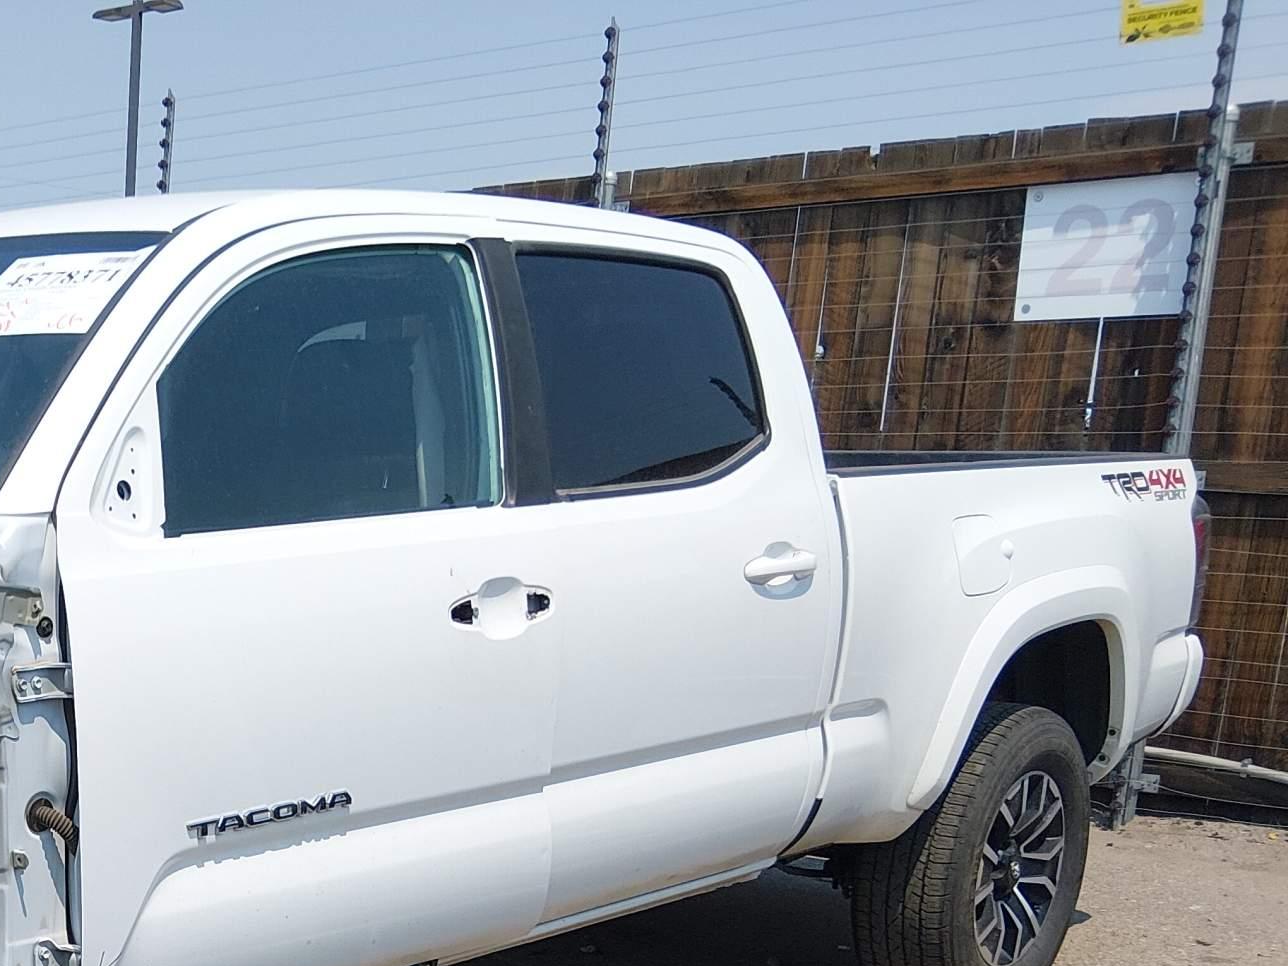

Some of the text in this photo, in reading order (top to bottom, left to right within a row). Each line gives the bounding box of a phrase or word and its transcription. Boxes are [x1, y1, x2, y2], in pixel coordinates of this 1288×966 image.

[1127, 11, 1168, 24] SECURITY
[1046, 198, 1176, 296] 22
[8, 269, 122, 287] 45778371
[1101, 472, 1151, 502] TRD
[1154, 489, 1187, 502] SPORT
[186, 788, 353, 839] TACOMA
